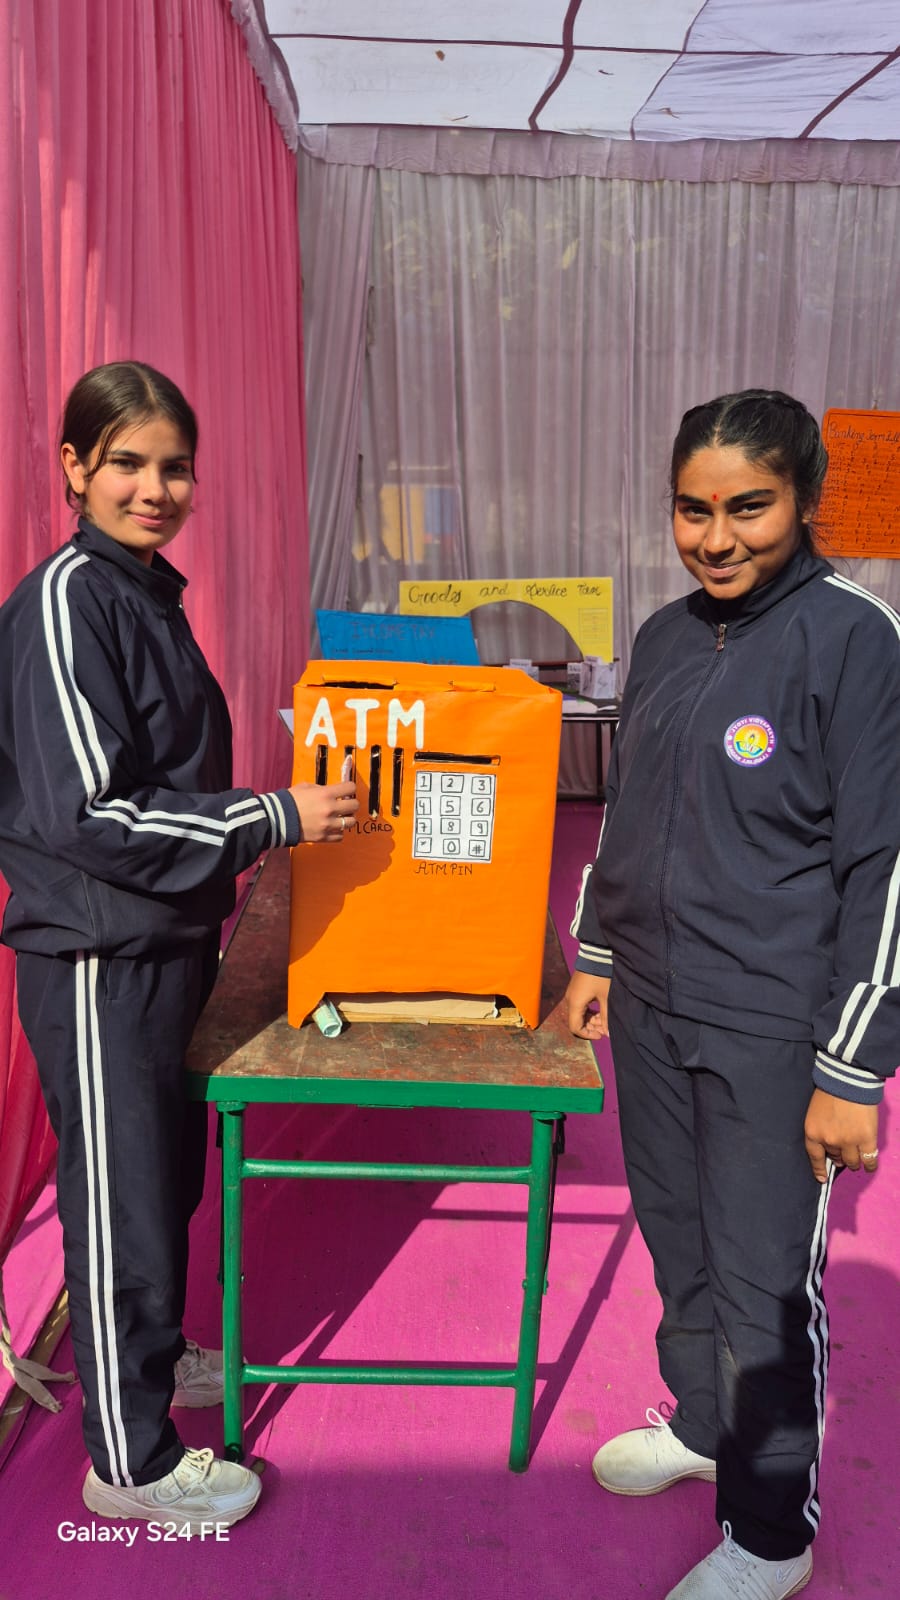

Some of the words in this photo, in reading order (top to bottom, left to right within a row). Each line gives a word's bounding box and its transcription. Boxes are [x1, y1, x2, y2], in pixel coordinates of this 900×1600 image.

[479, 583, 508, 596] and
[304, 696, 425, 749] ATM
[420, 775, 428, 787] 1
[446, 777, 454, 788] 2
[478, 779, 486, 791] 3
[445, 800, 455, 813] 5
[476, 800, 484, 813] 6
[447, 822, 455, 832] 8
[477, 822, 484, 834] 9
[415, 862, 447, 875] ATM
[449, 863, 473, 876] PIN
